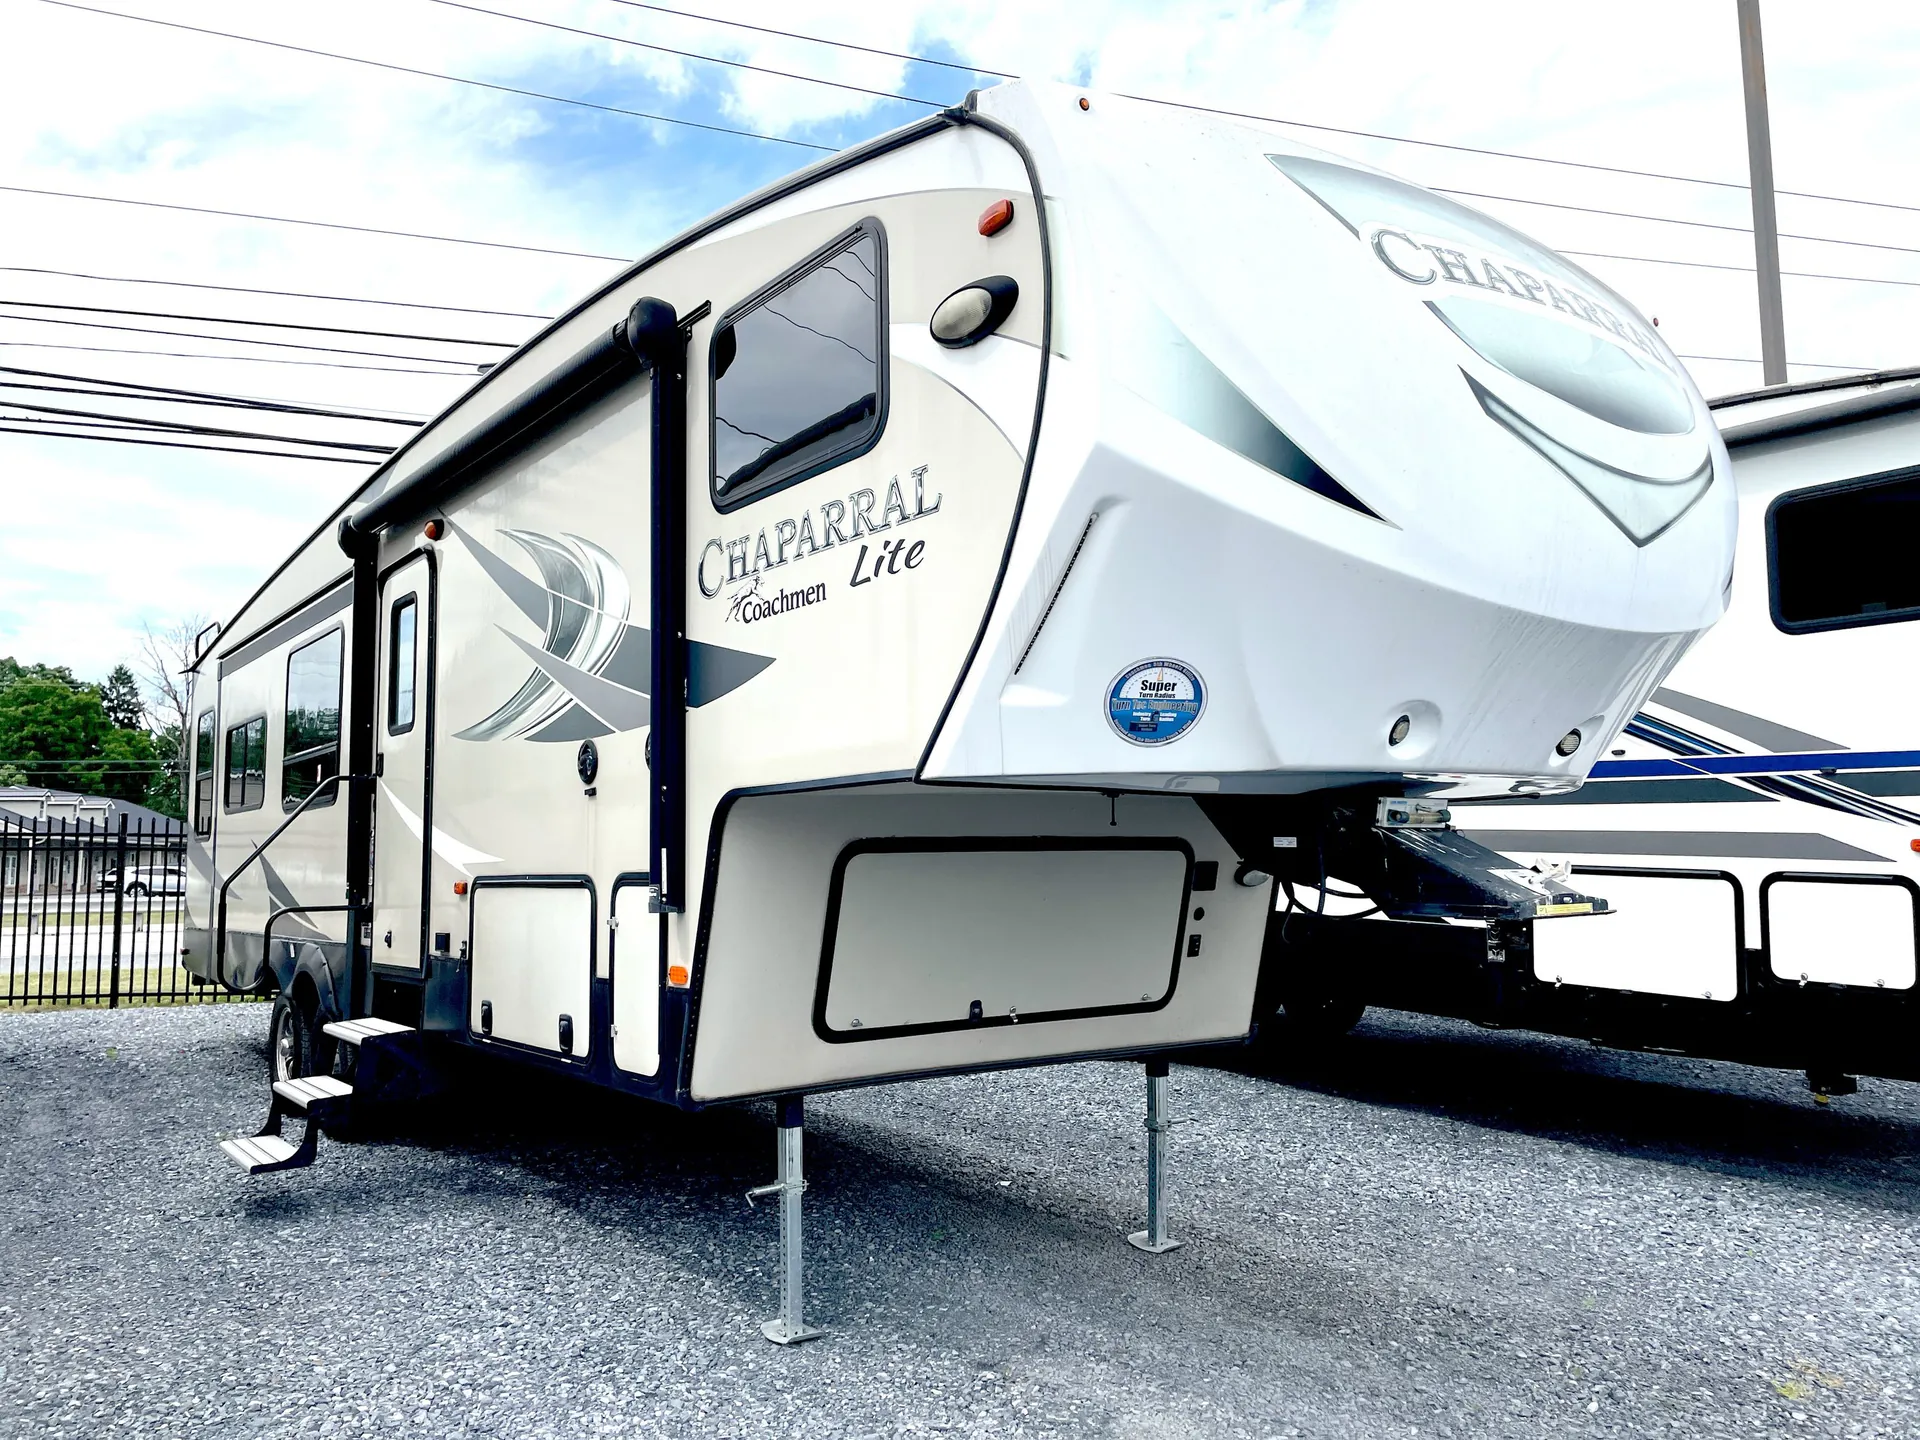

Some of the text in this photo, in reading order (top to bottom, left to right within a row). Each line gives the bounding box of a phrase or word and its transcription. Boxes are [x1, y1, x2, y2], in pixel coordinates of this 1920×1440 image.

[698, 464, 943, 599] CHAPARRAL
[849, 537, 926, 588] Lite
[741, 581, 827, 624] Coachmen
[1140, 680, 1177, 692] Super
